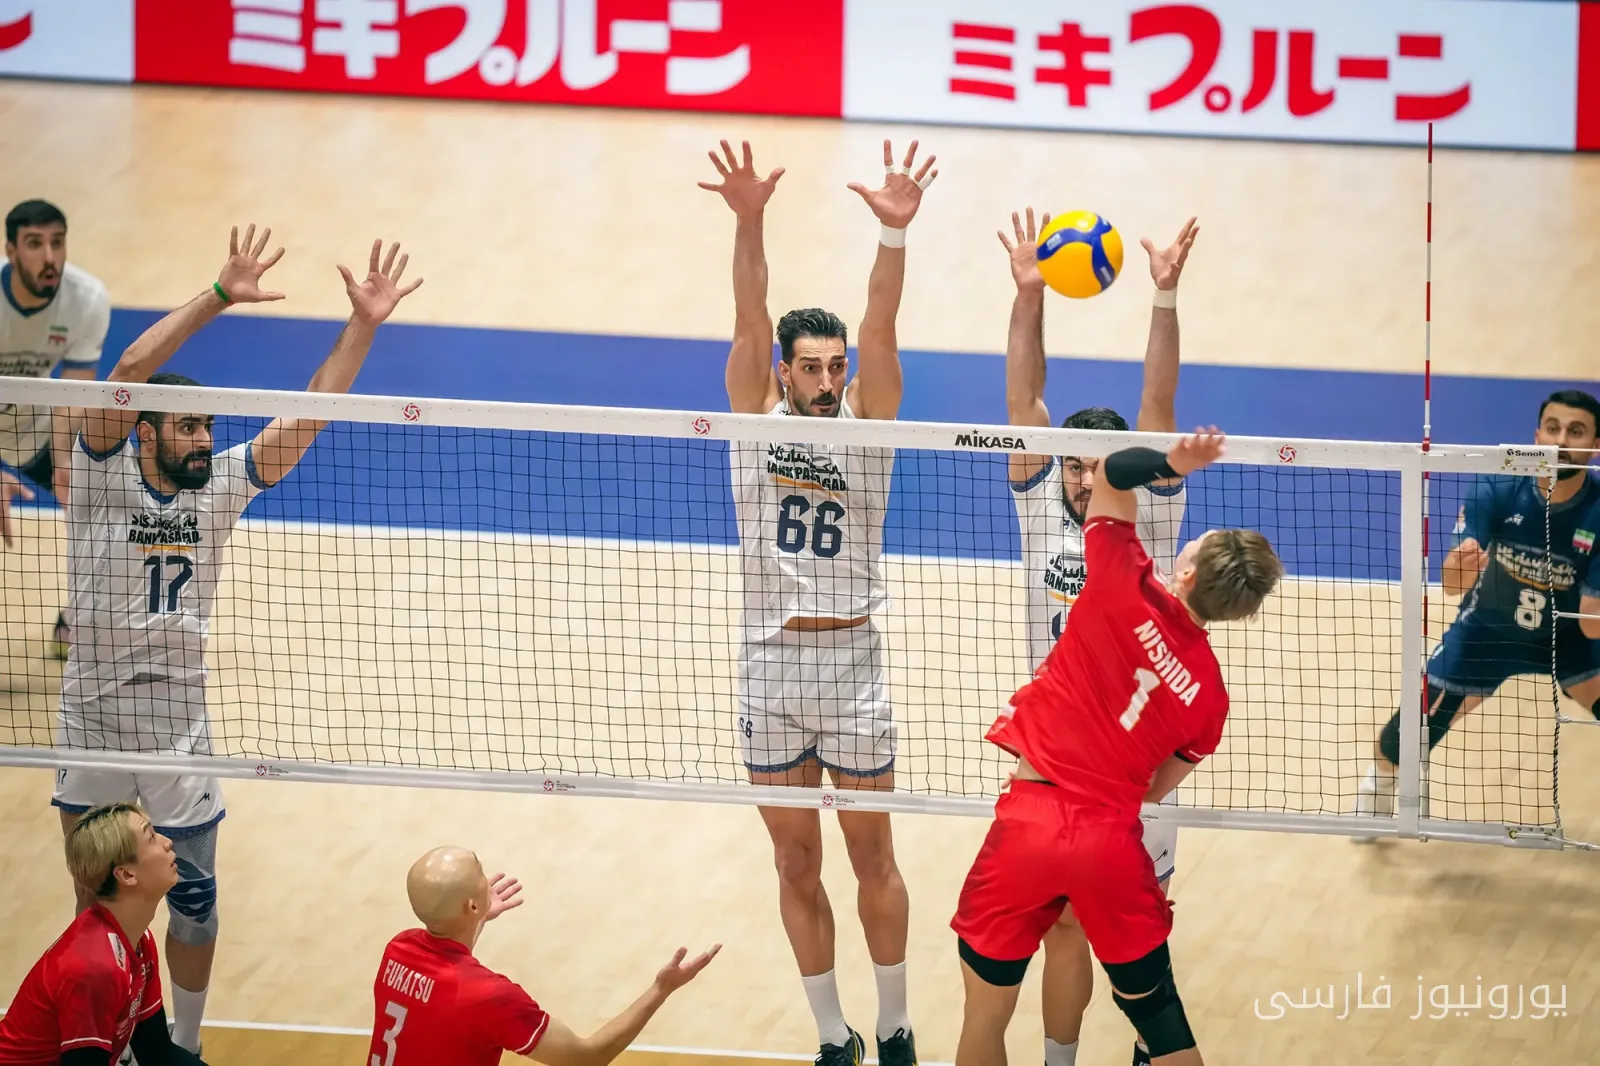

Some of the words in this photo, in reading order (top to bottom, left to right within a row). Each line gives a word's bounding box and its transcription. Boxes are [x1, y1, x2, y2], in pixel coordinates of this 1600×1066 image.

[229, 0, 751, 96] ミキプルーン
[949, 3, 1471, 121] ミキプルーン
[955, 431, 1026, 450] MIKASA
[777, 495, 845, 558] 66
[144, 555, 193, 613] 17
[1514, 588, 1547, 631] 8
[1133, 619, 1201, 707] NISHIDA
[1119, 667, 1160, 731] 1
[382, 958, 435, 1003] FUKATSU
[371, 1000, 408, 1066] 3
